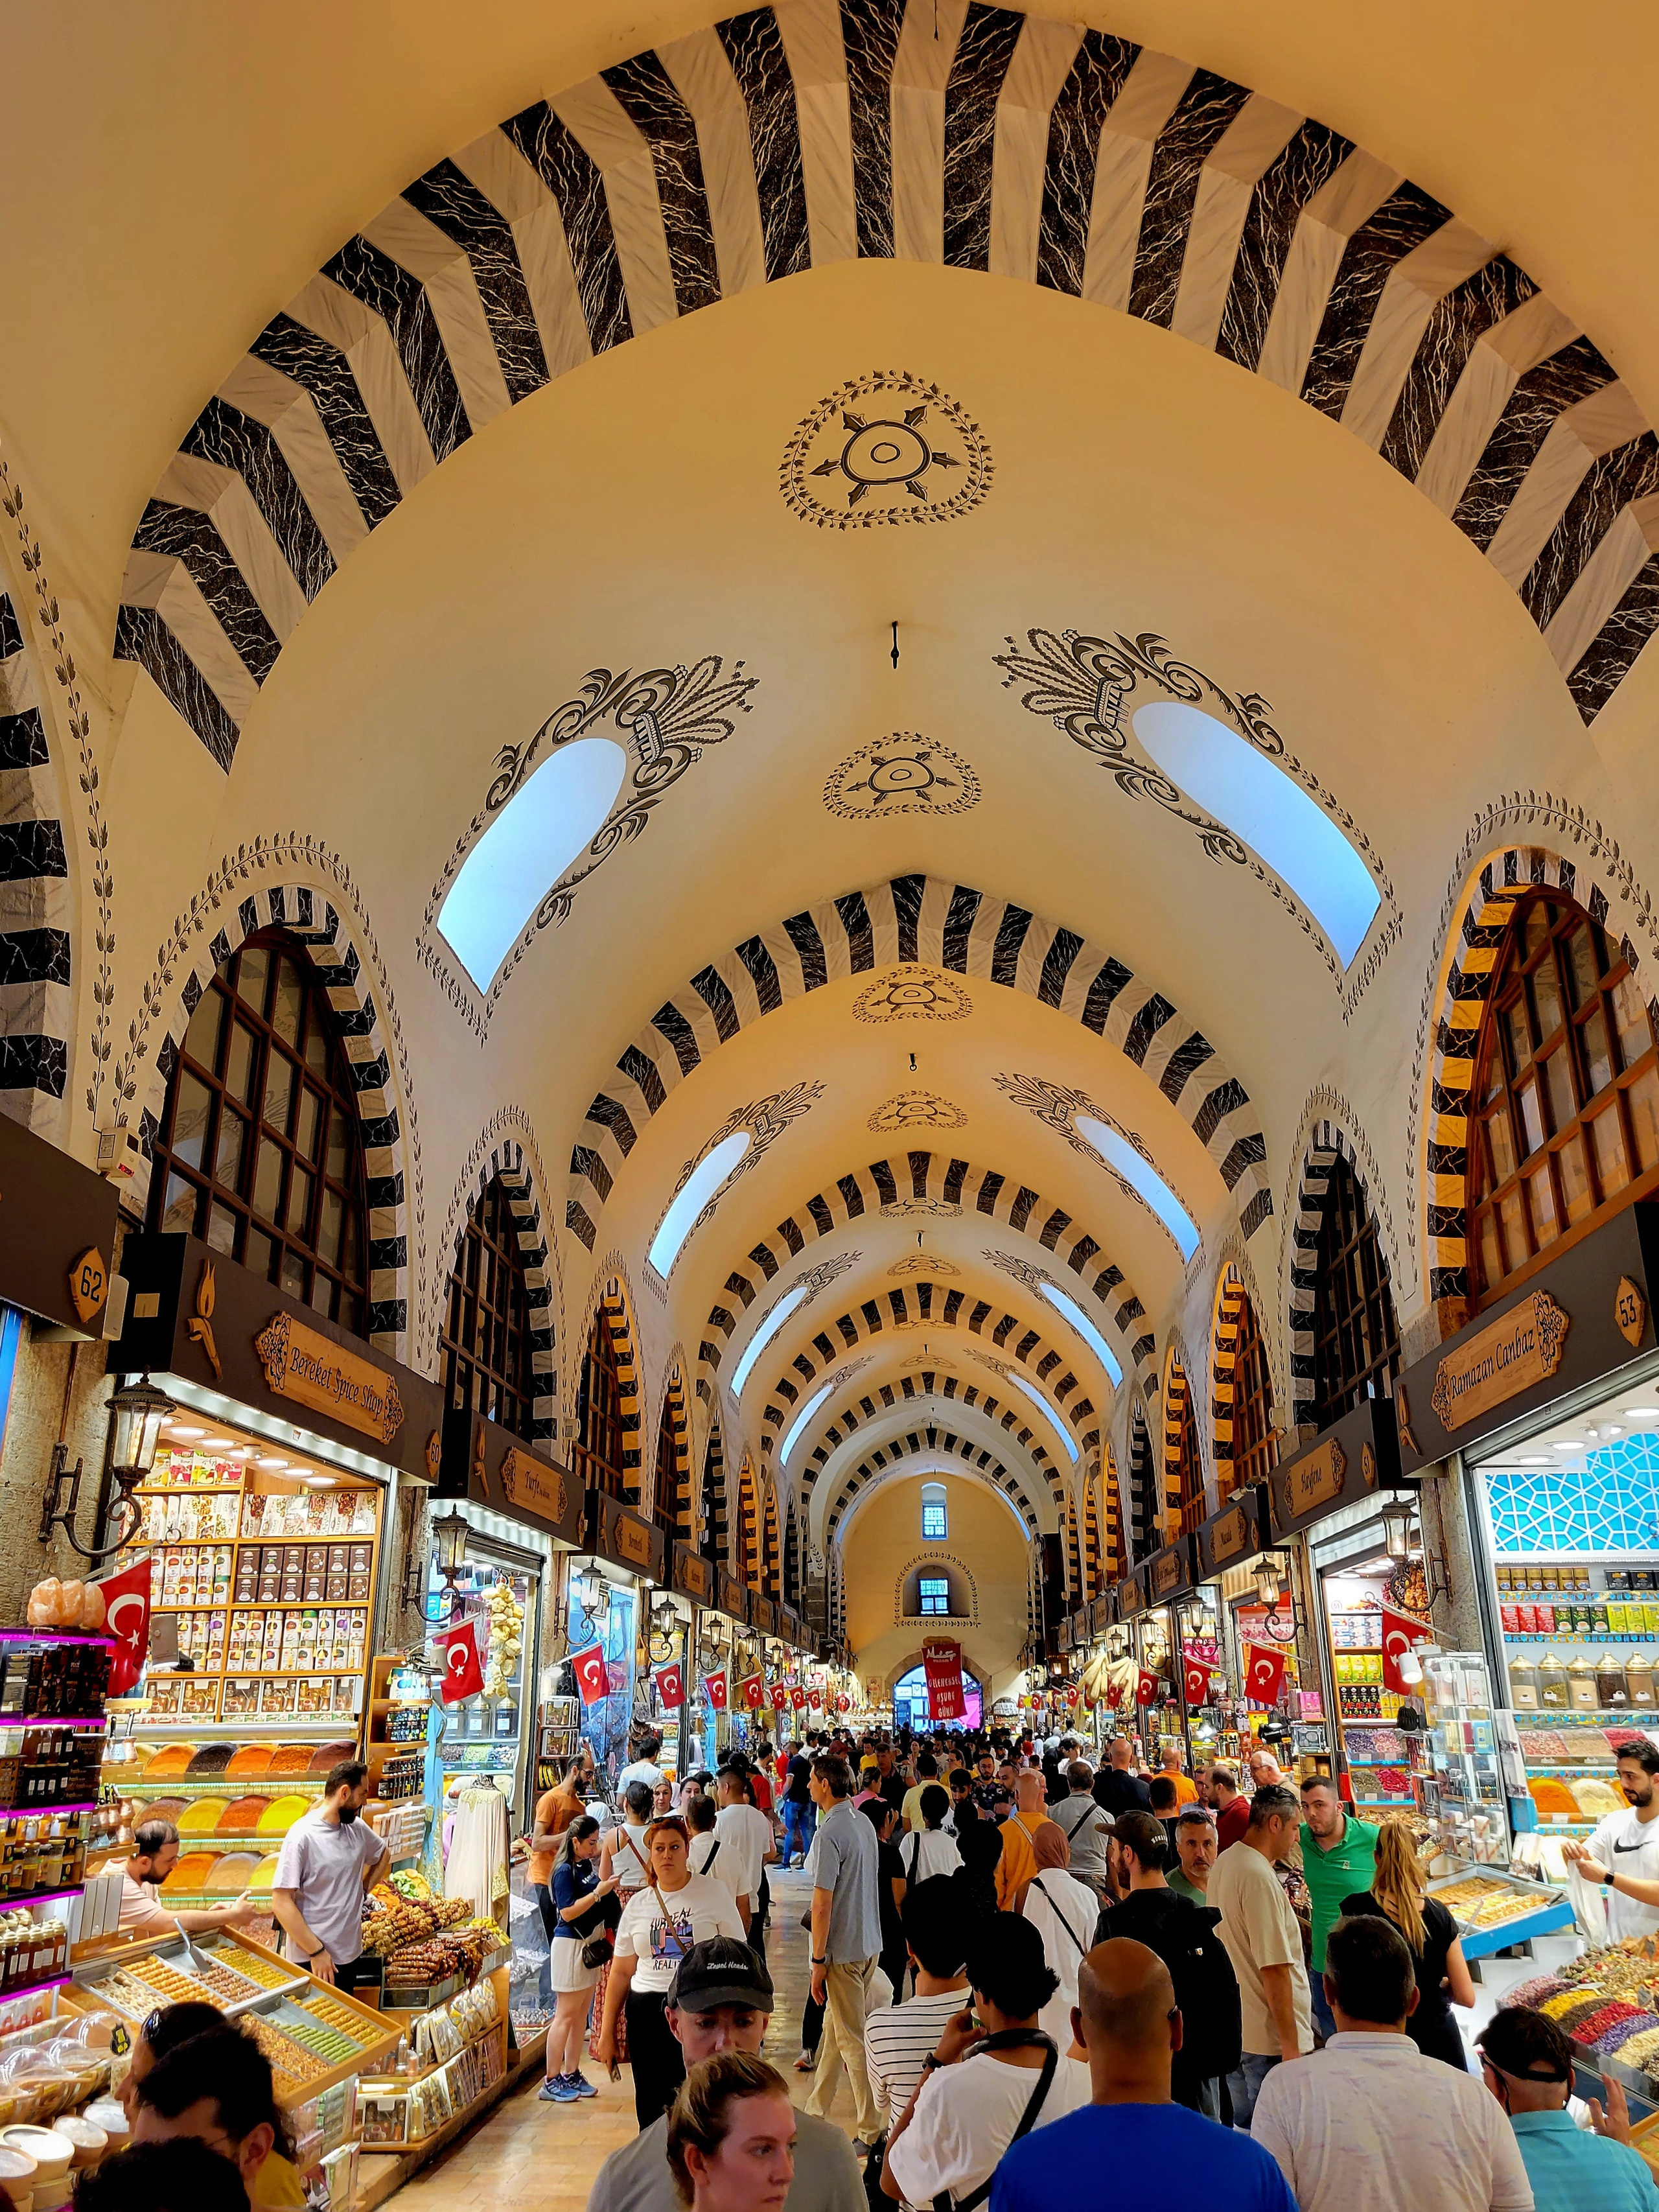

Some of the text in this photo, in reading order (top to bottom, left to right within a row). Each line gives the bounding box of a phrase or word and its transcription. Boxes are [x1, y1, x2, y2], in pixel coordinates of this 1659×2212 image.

[80, 1265, 102, 1303] 62
[1619, 1294, 1636, 1327] 53
[1450, 1326, 1535, 1400] Ramazan Canbaz
[290, 1347, 383, 1422] Bereket Spice Shop
[431, 1442, 439, 1463] 60
[1363, 1455, 1370, 1475] 51
